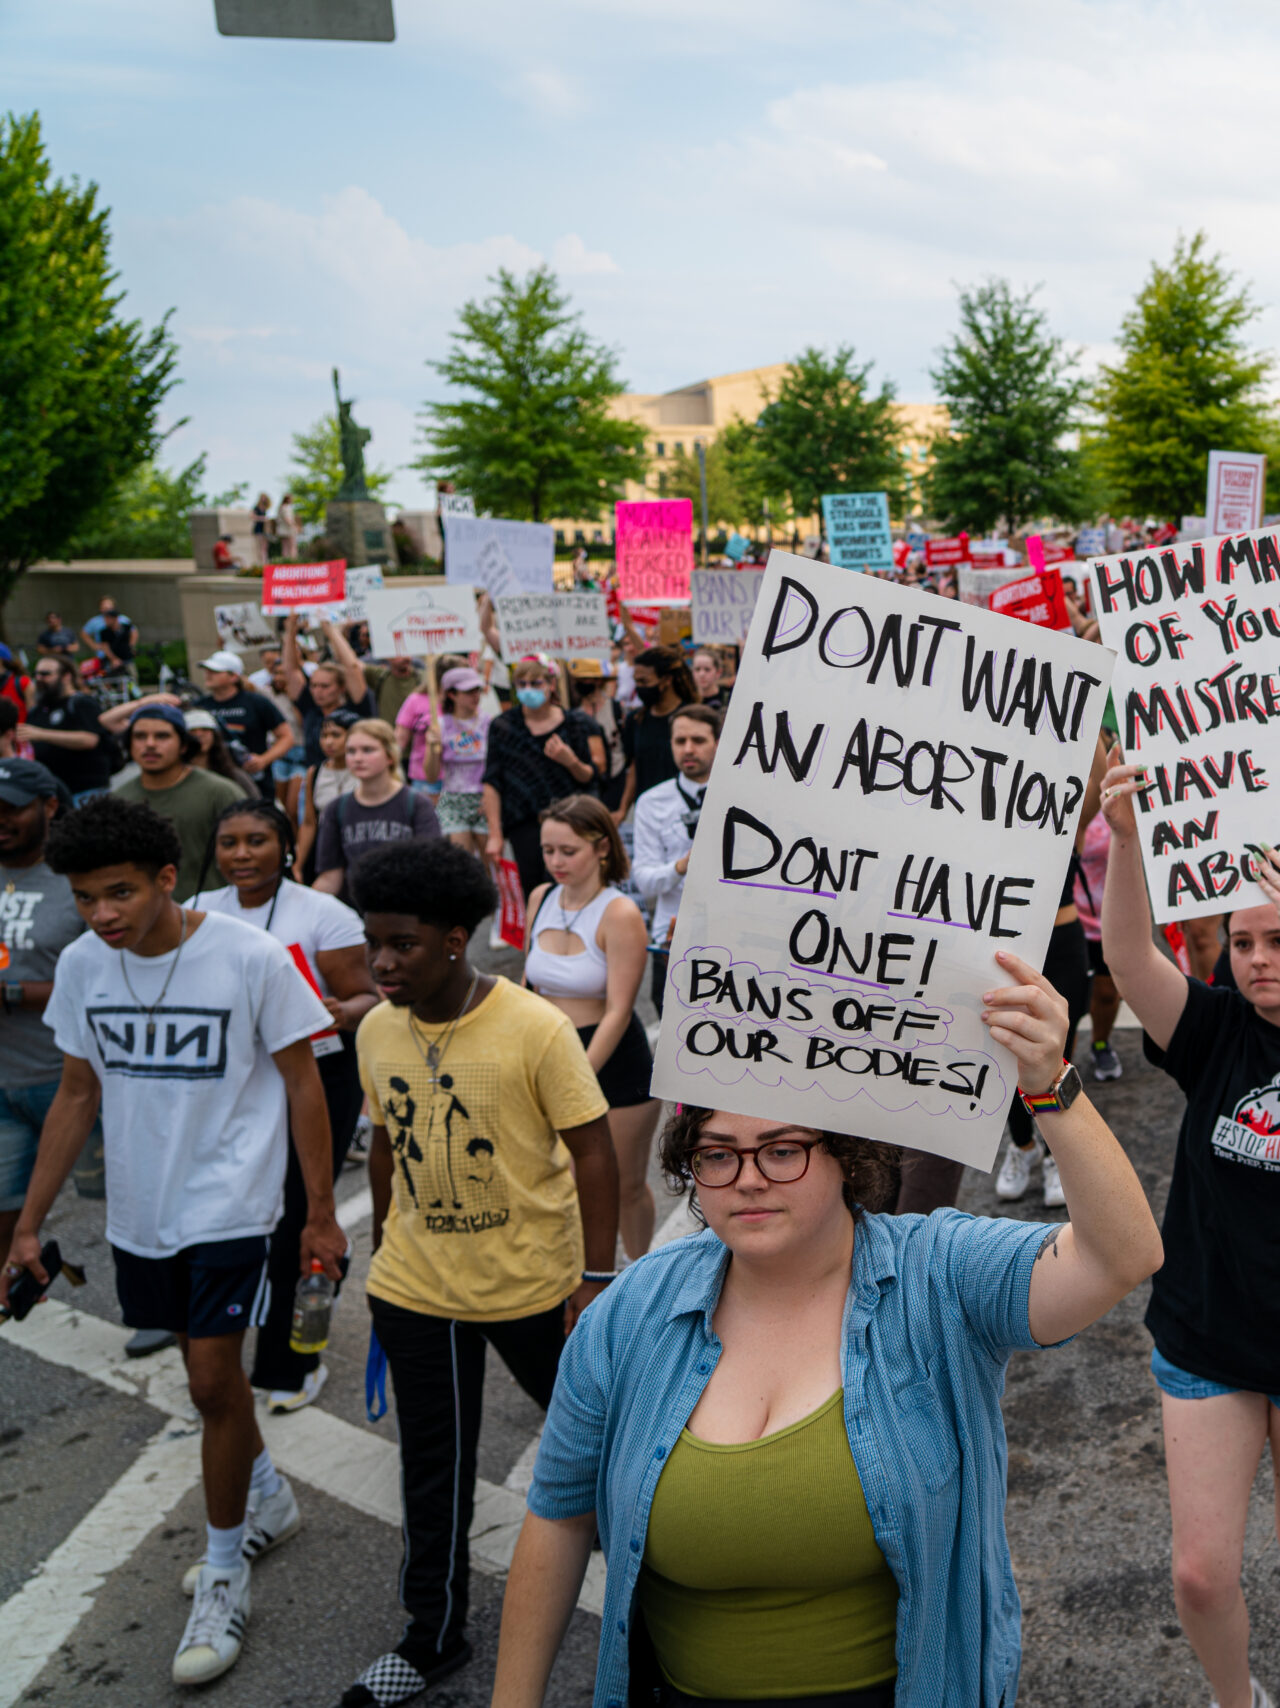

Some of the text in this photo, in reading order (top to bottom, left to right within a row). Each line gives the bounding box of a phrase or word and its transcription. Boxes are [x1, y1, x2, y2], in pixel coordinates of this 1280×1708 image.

[623, 553, 687, 574] FORCED
[623, 575, 685, 597] BIRTH
[1094, 543, 1205, 613] HOW
[697, 610, 734, 636] OUR
[1125, 612, 1193, 667] OF
[962, 635, 1101, 742] WANT
[733, 702, 1084, 835] AN ABORTION?
[1135, 749, 1269, 813] HAVE
[1152, 810, 1220, 857] AN
[894, 854, 1035, 938] HAVE
[789, 909, 938, 998] ONE!
[689, 959, 940, 1041] BANS OFF
[686, 1021, 989, 1112] OUR BODIES!
